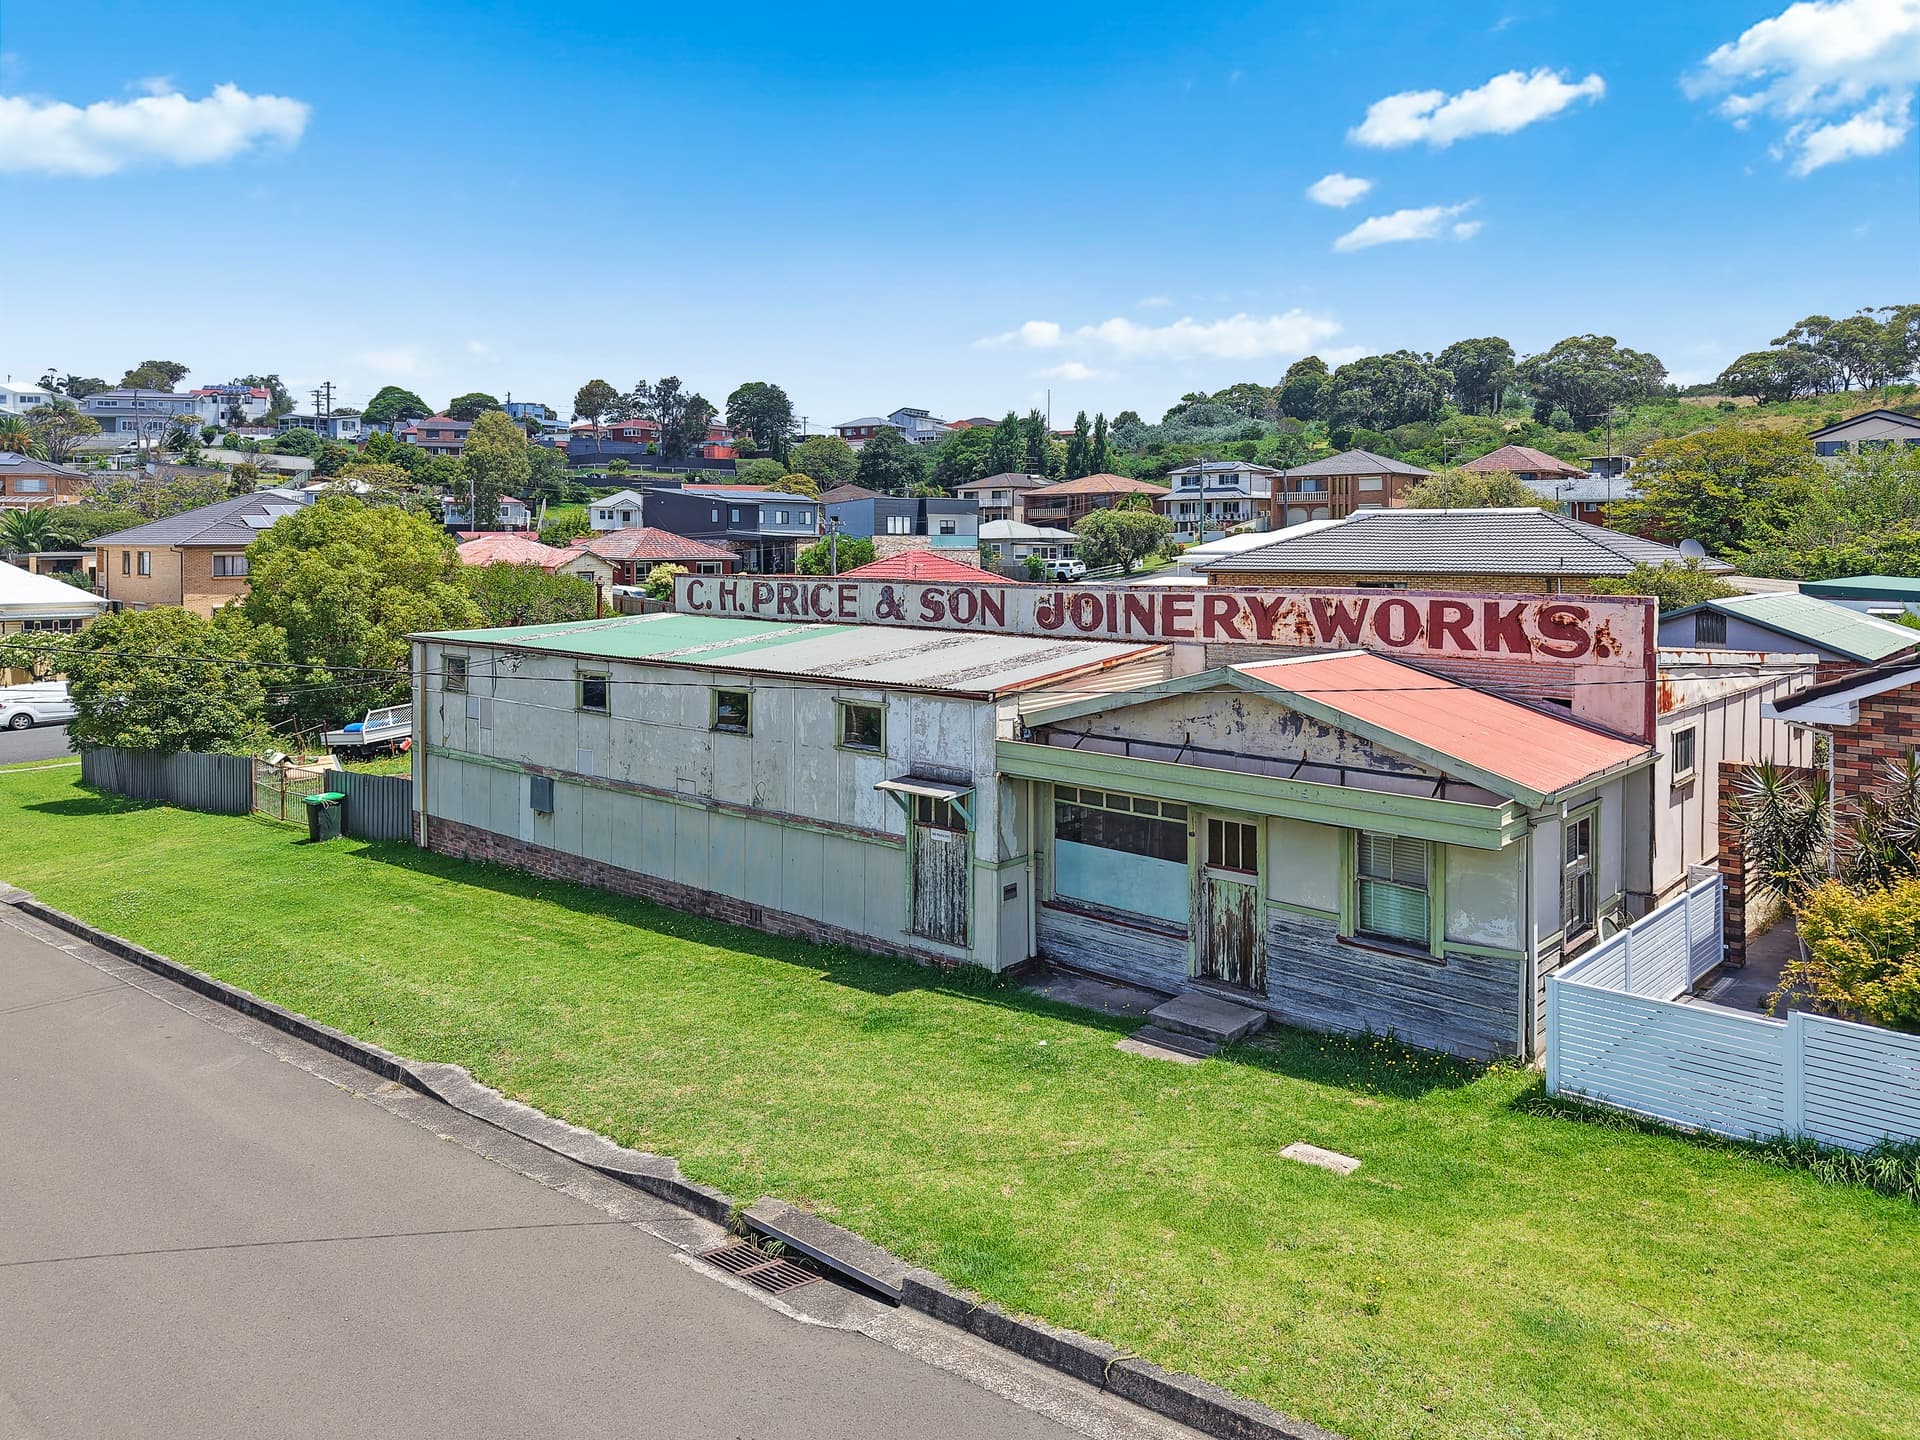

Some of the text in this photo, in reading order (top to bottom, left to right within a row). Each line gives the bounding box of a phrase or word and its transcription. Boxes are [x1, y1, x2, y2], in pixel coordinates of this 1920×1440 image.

[875, 585, 906, 621] &
[919, 587, 1005, 627] SON
[1035, 592, 1287, 641] JOINERY
[1310, 597, 1611, 660] WORKS.
